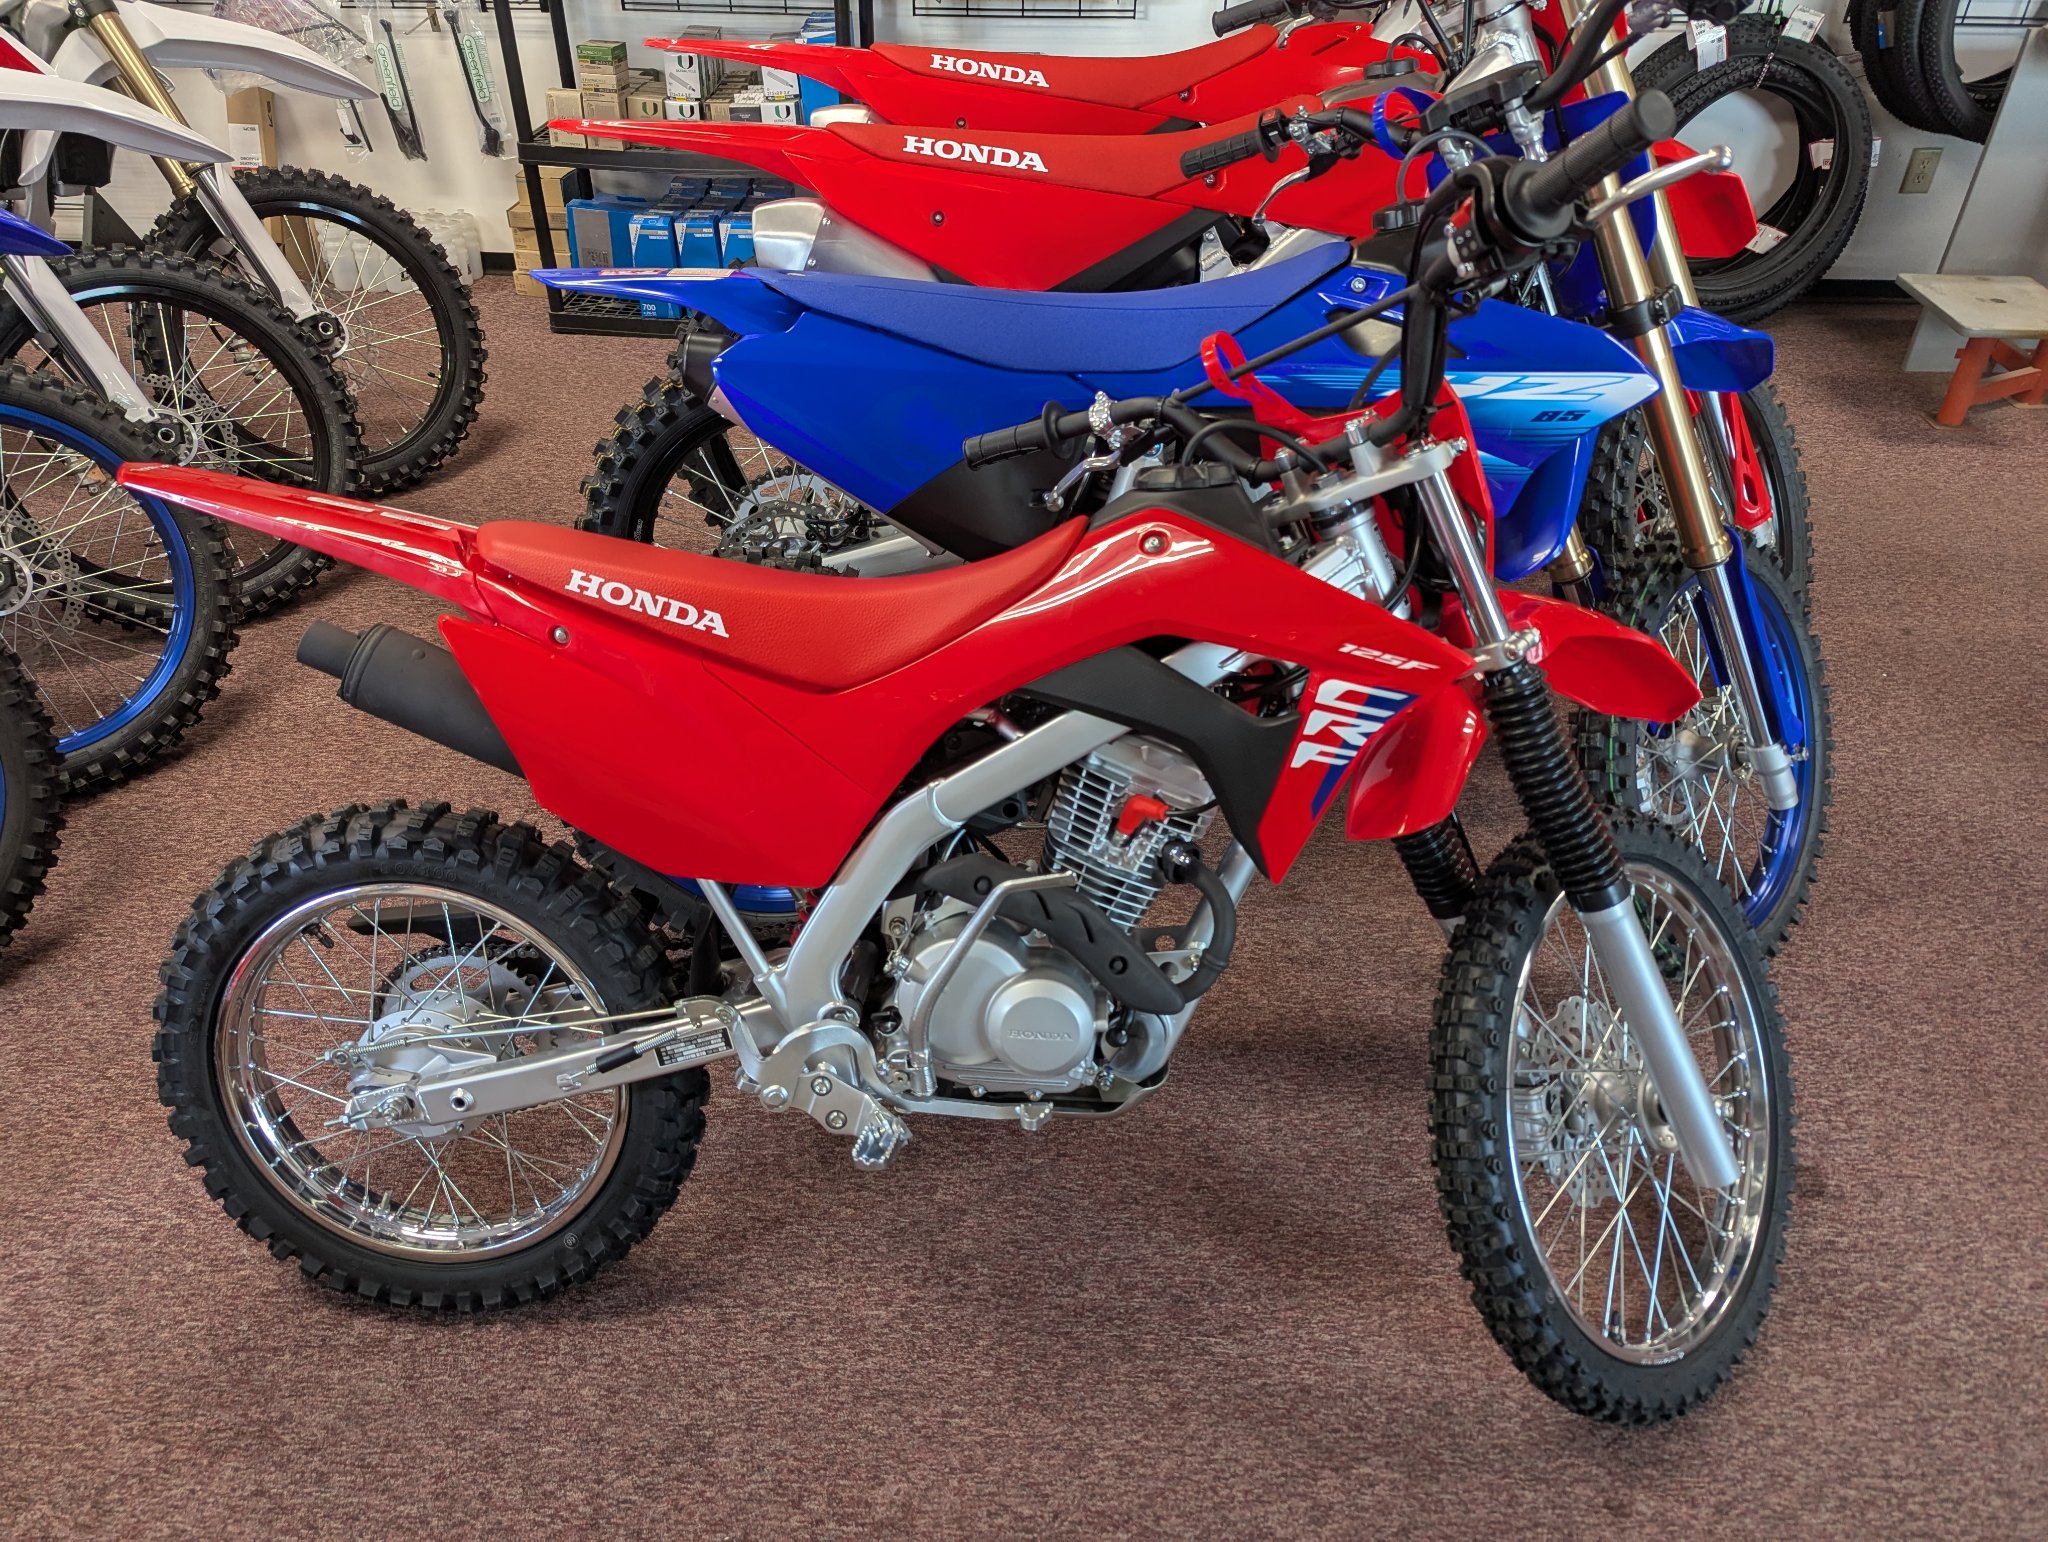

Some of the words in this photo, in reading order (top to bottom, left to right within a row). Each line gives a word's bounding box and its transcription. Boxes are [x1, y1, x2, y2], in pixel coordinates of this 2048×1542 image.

[376, 46, 402, 108] greenfield
[463, 37, 488, 100] greenfield
[930, 53, 1050, 88] HONDA
[902, 135, 1049, 173] HONDA
[641, 303, 656, 311] 700
[1529, 410, 1592, 423] 85
[564, 568, 730, 639] HONDA
[1337, 642, 1441, 671] 125F
[1290, 678, 1409, 769] CRF
[1007, 1029, 1074, 1042] HONDA
